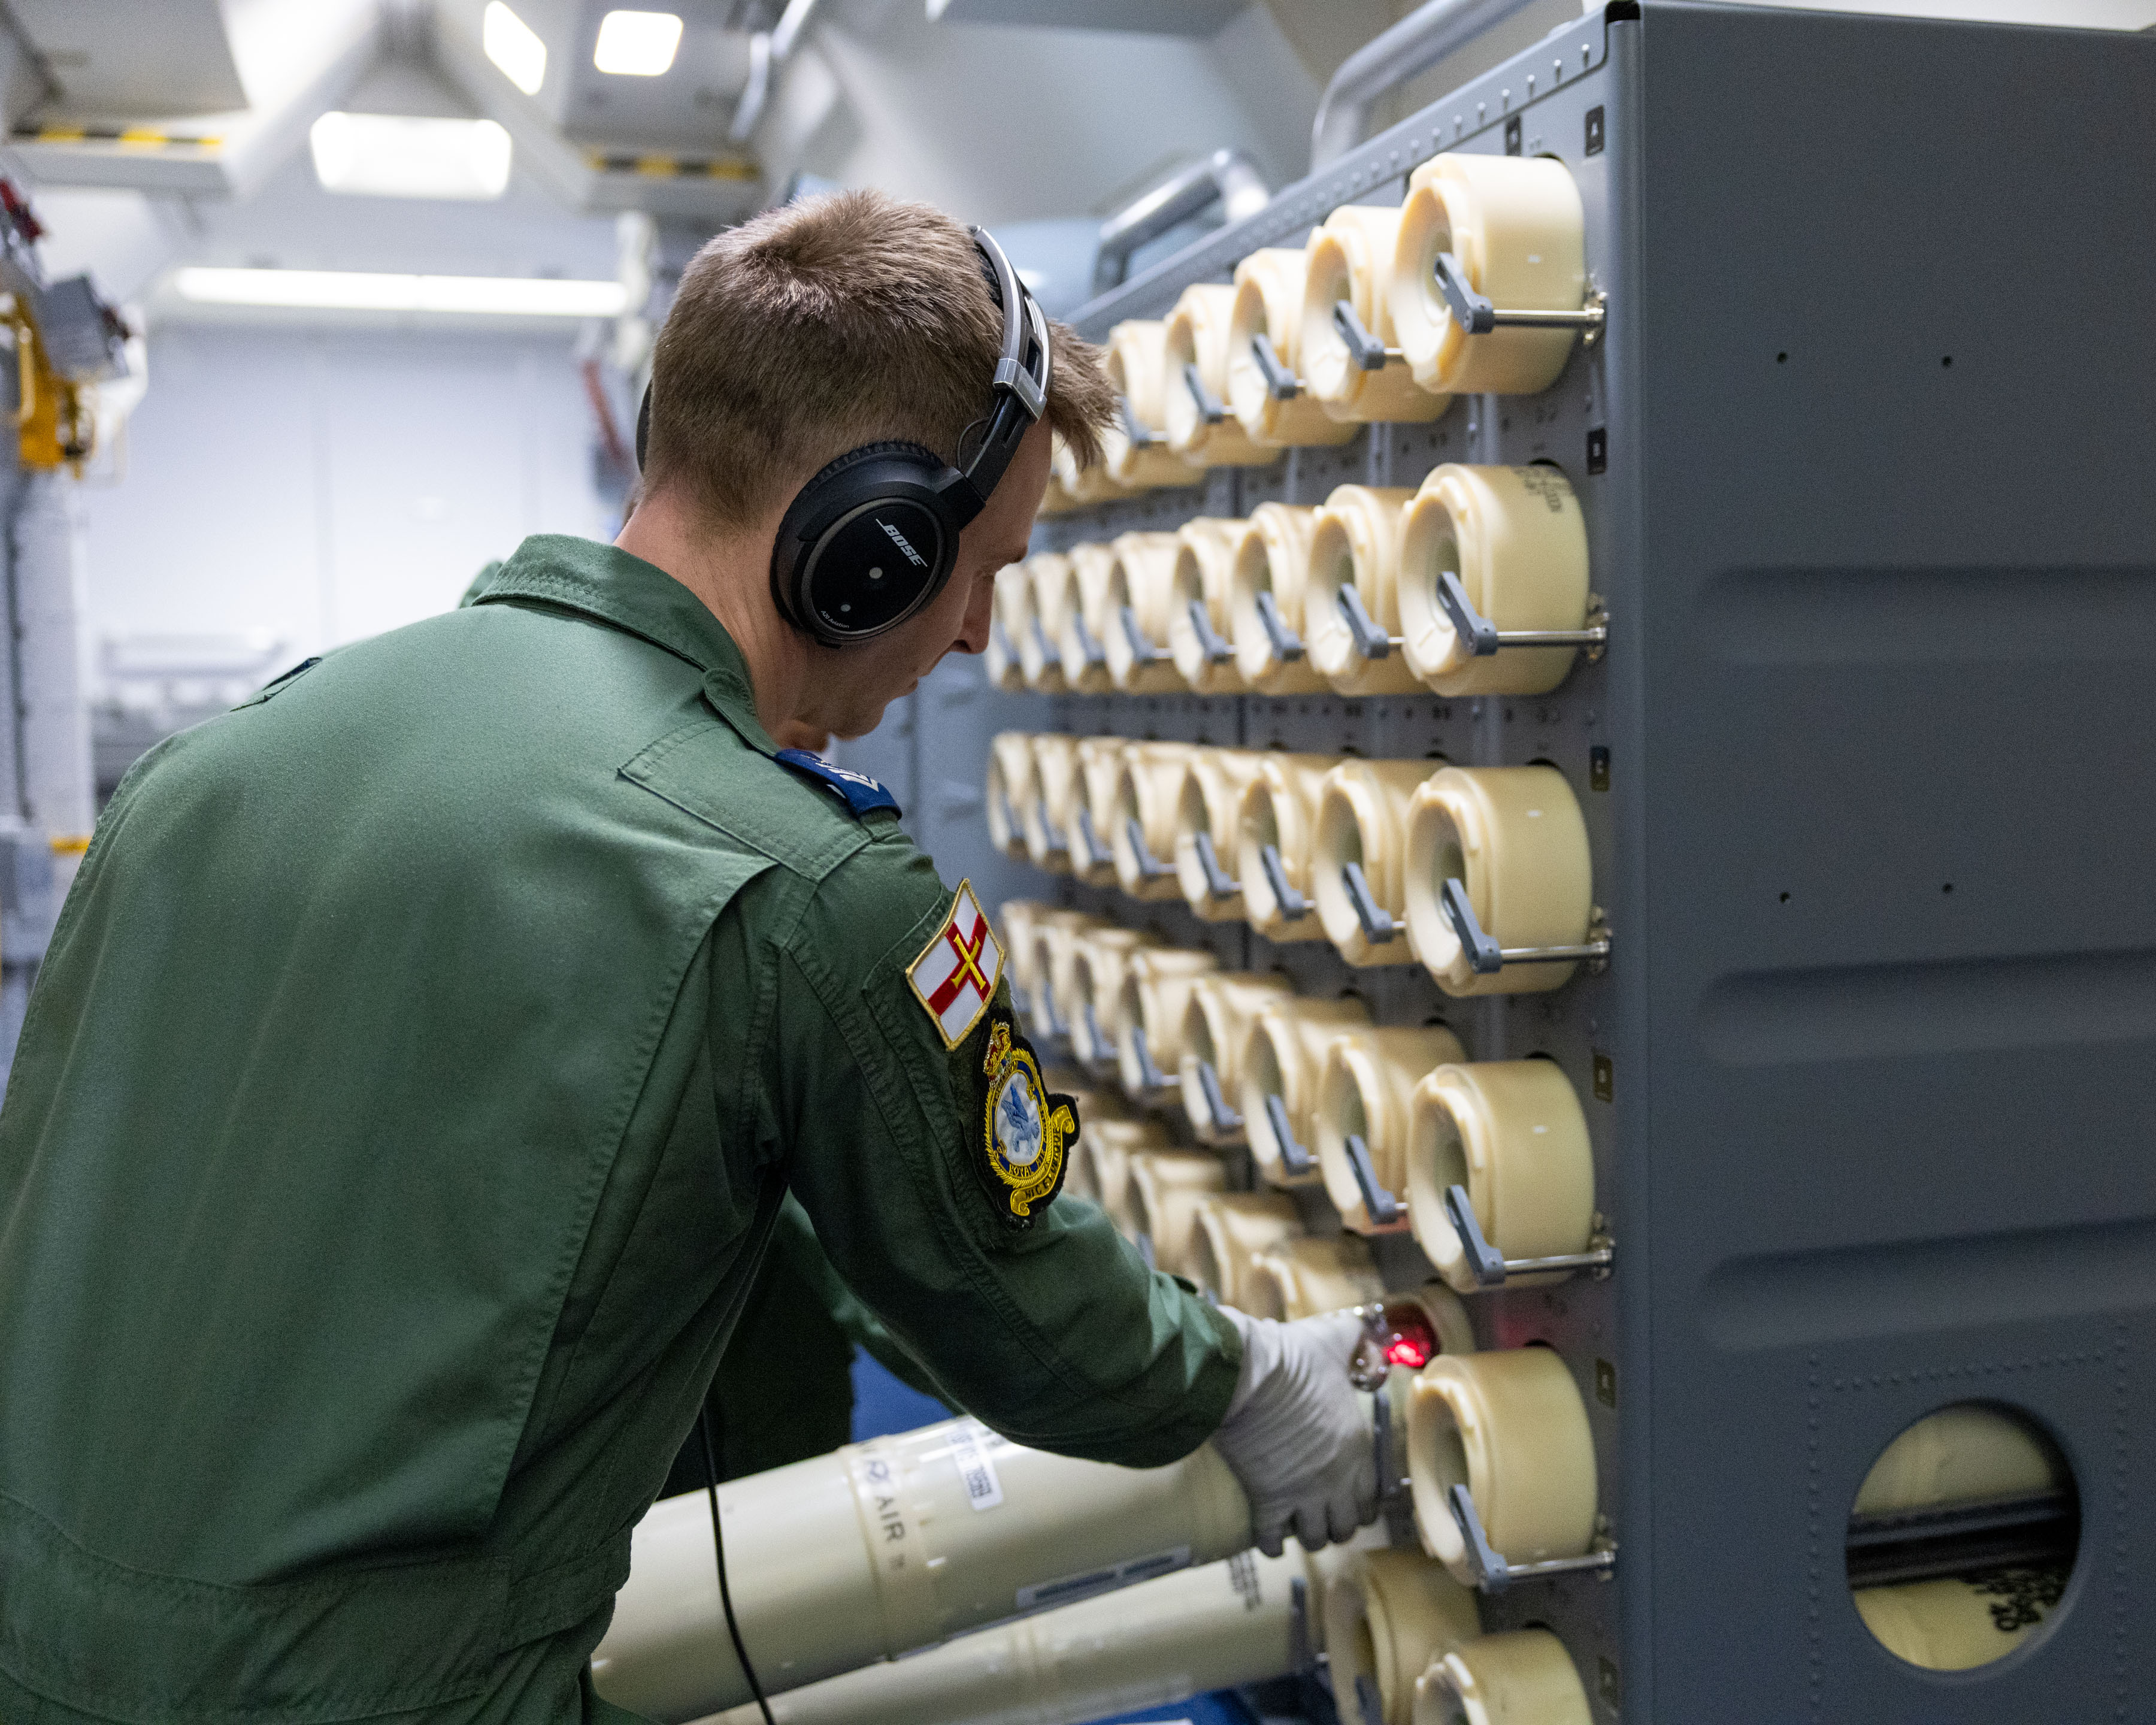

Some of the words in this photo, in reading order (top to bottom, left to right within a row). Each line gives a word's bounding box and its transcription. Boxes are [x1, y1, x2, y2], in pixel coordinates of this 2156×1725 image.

[875, 518, 928, 567] BOSE
[820, 611, 830, 619] A20
[828, 618, 849, 628] Aviation
[1009, 1163, 1035, 1178] ROYAL
[1025, 1185, 1042, 1199] HIC
[876, 1496, 906, 1543] AIR
